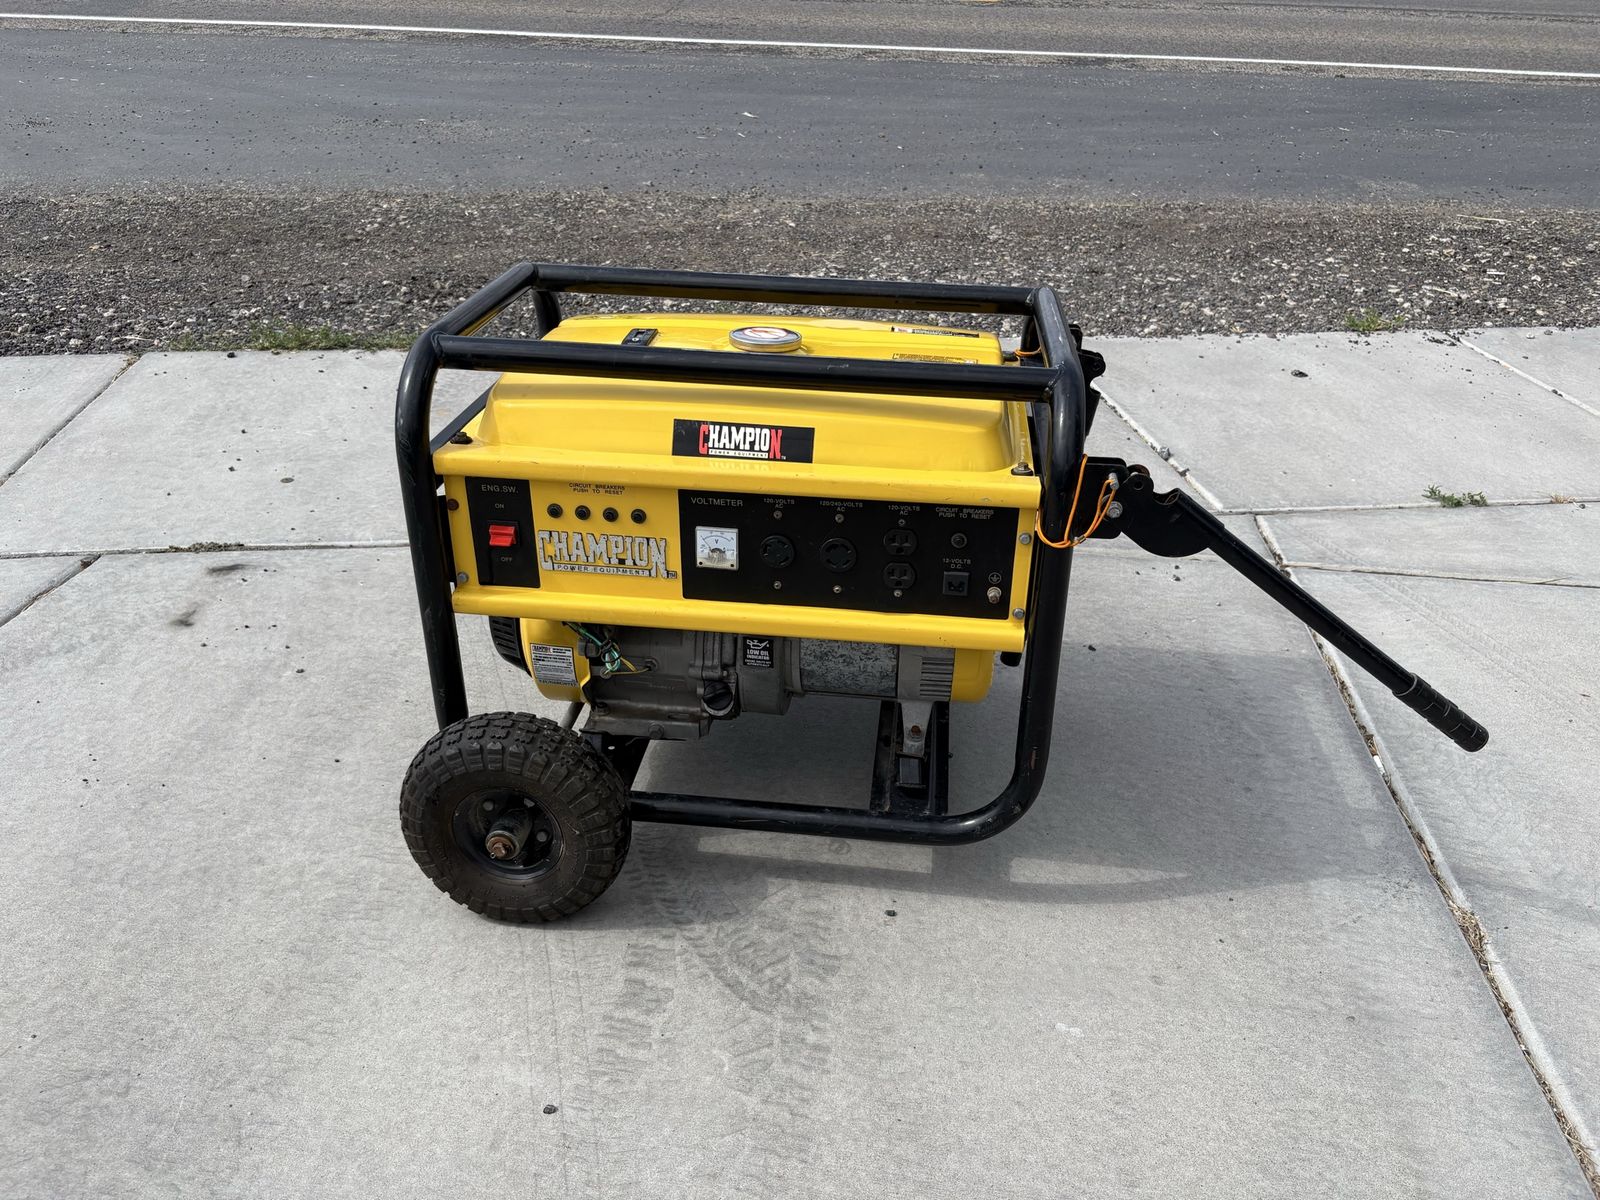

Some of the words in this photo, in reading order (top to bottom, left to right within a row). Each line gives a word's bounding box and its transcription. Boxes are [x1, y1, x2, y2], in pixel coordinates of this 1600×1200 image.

[699, 424, 782, 459] CHAMPION
[690, 497, 743, 507] VOLTMETER
[538, 530, 668, 579] CHAMPION
[557, 564, 589, 572] POWER
[594, 567, 646, 575] EQUIPMENT
